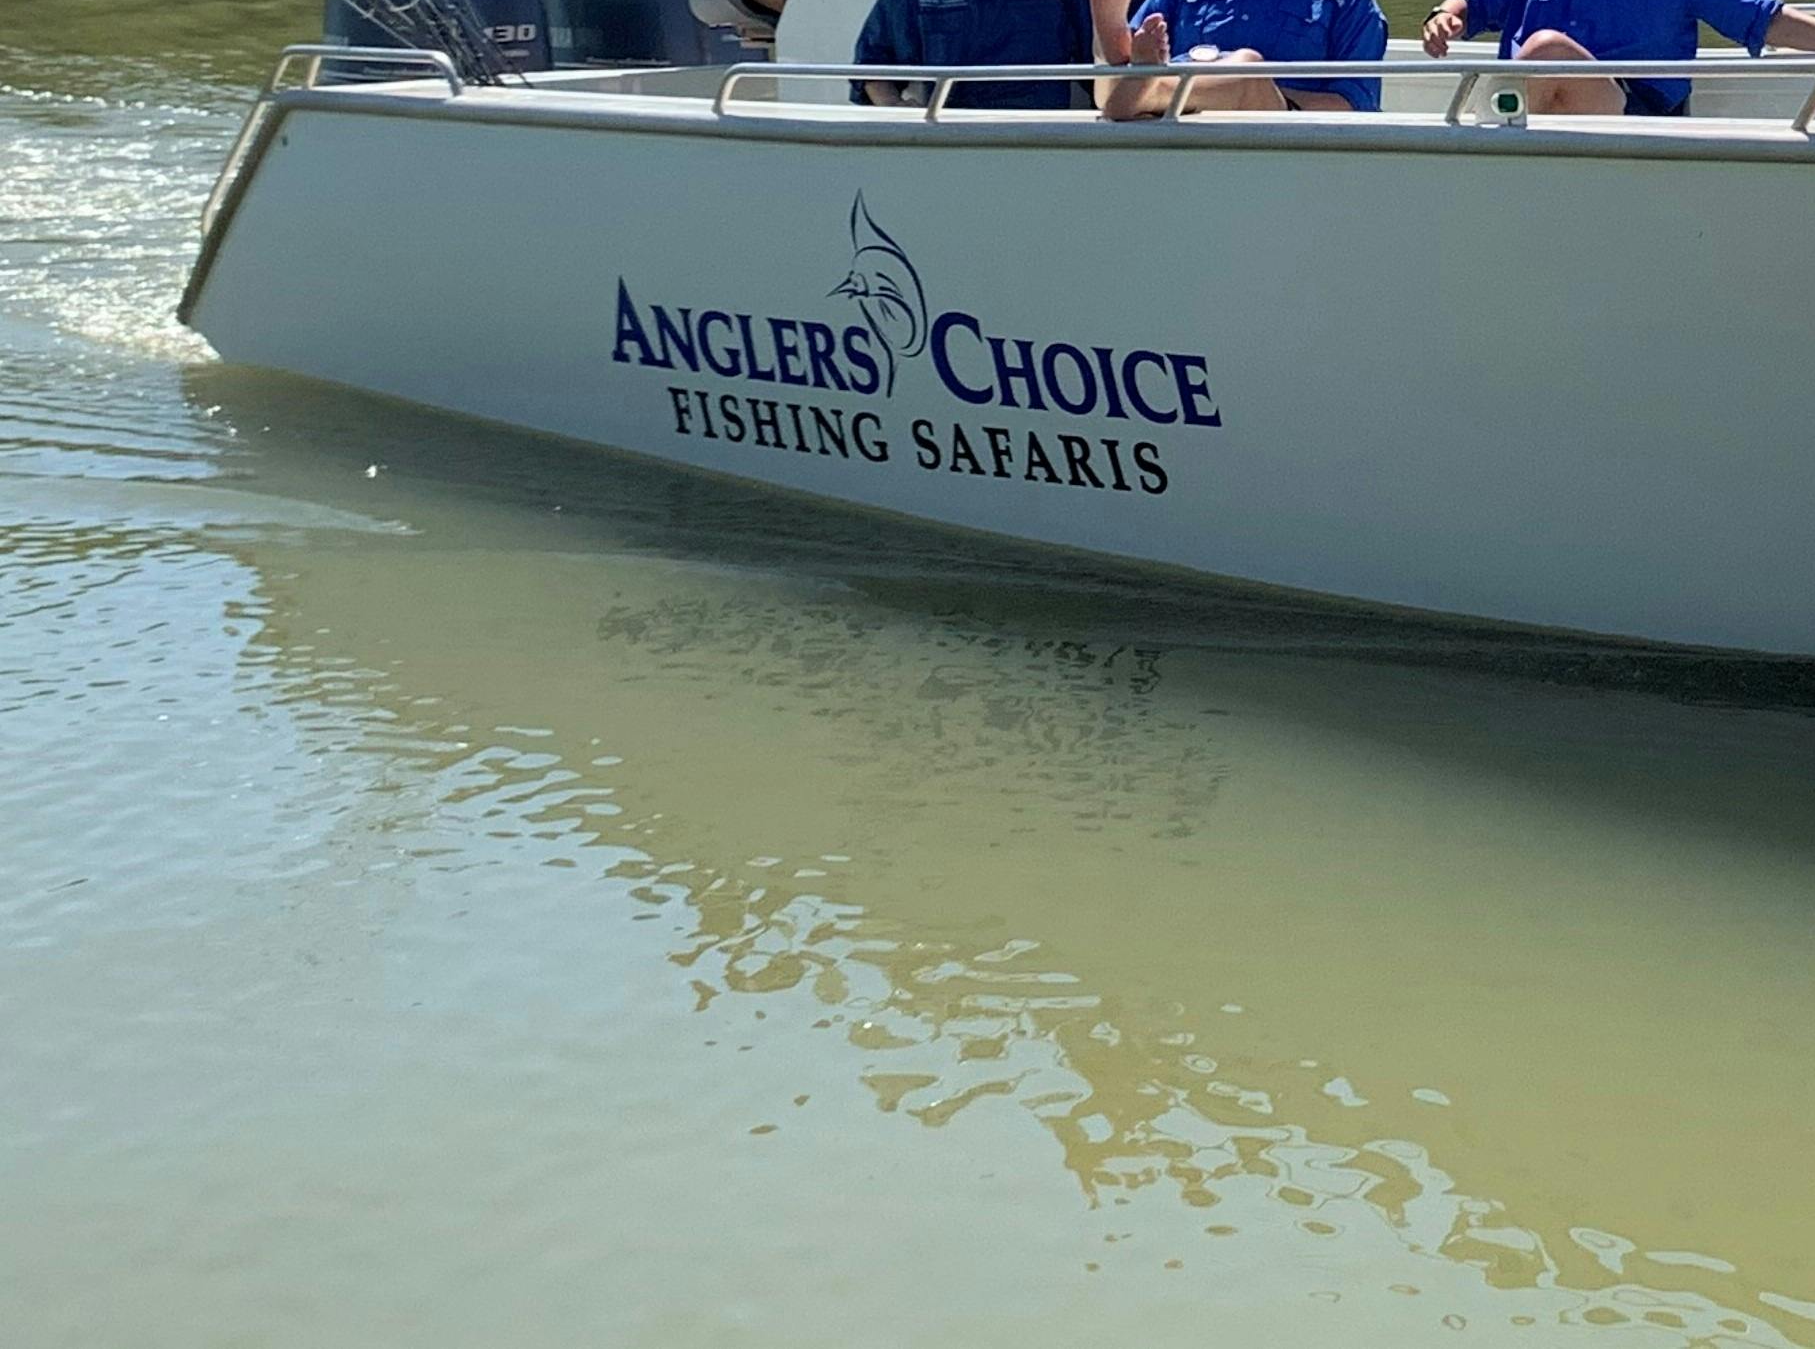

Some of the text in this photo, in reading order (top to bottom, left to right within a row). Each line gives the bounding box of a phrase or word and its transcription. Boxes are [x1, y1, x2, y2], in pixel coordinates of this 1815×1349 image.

[611, 276, 1223, 428] ANGLERS CHOICE
[666, 386, 1169, 495] FISHING SAFARIS
